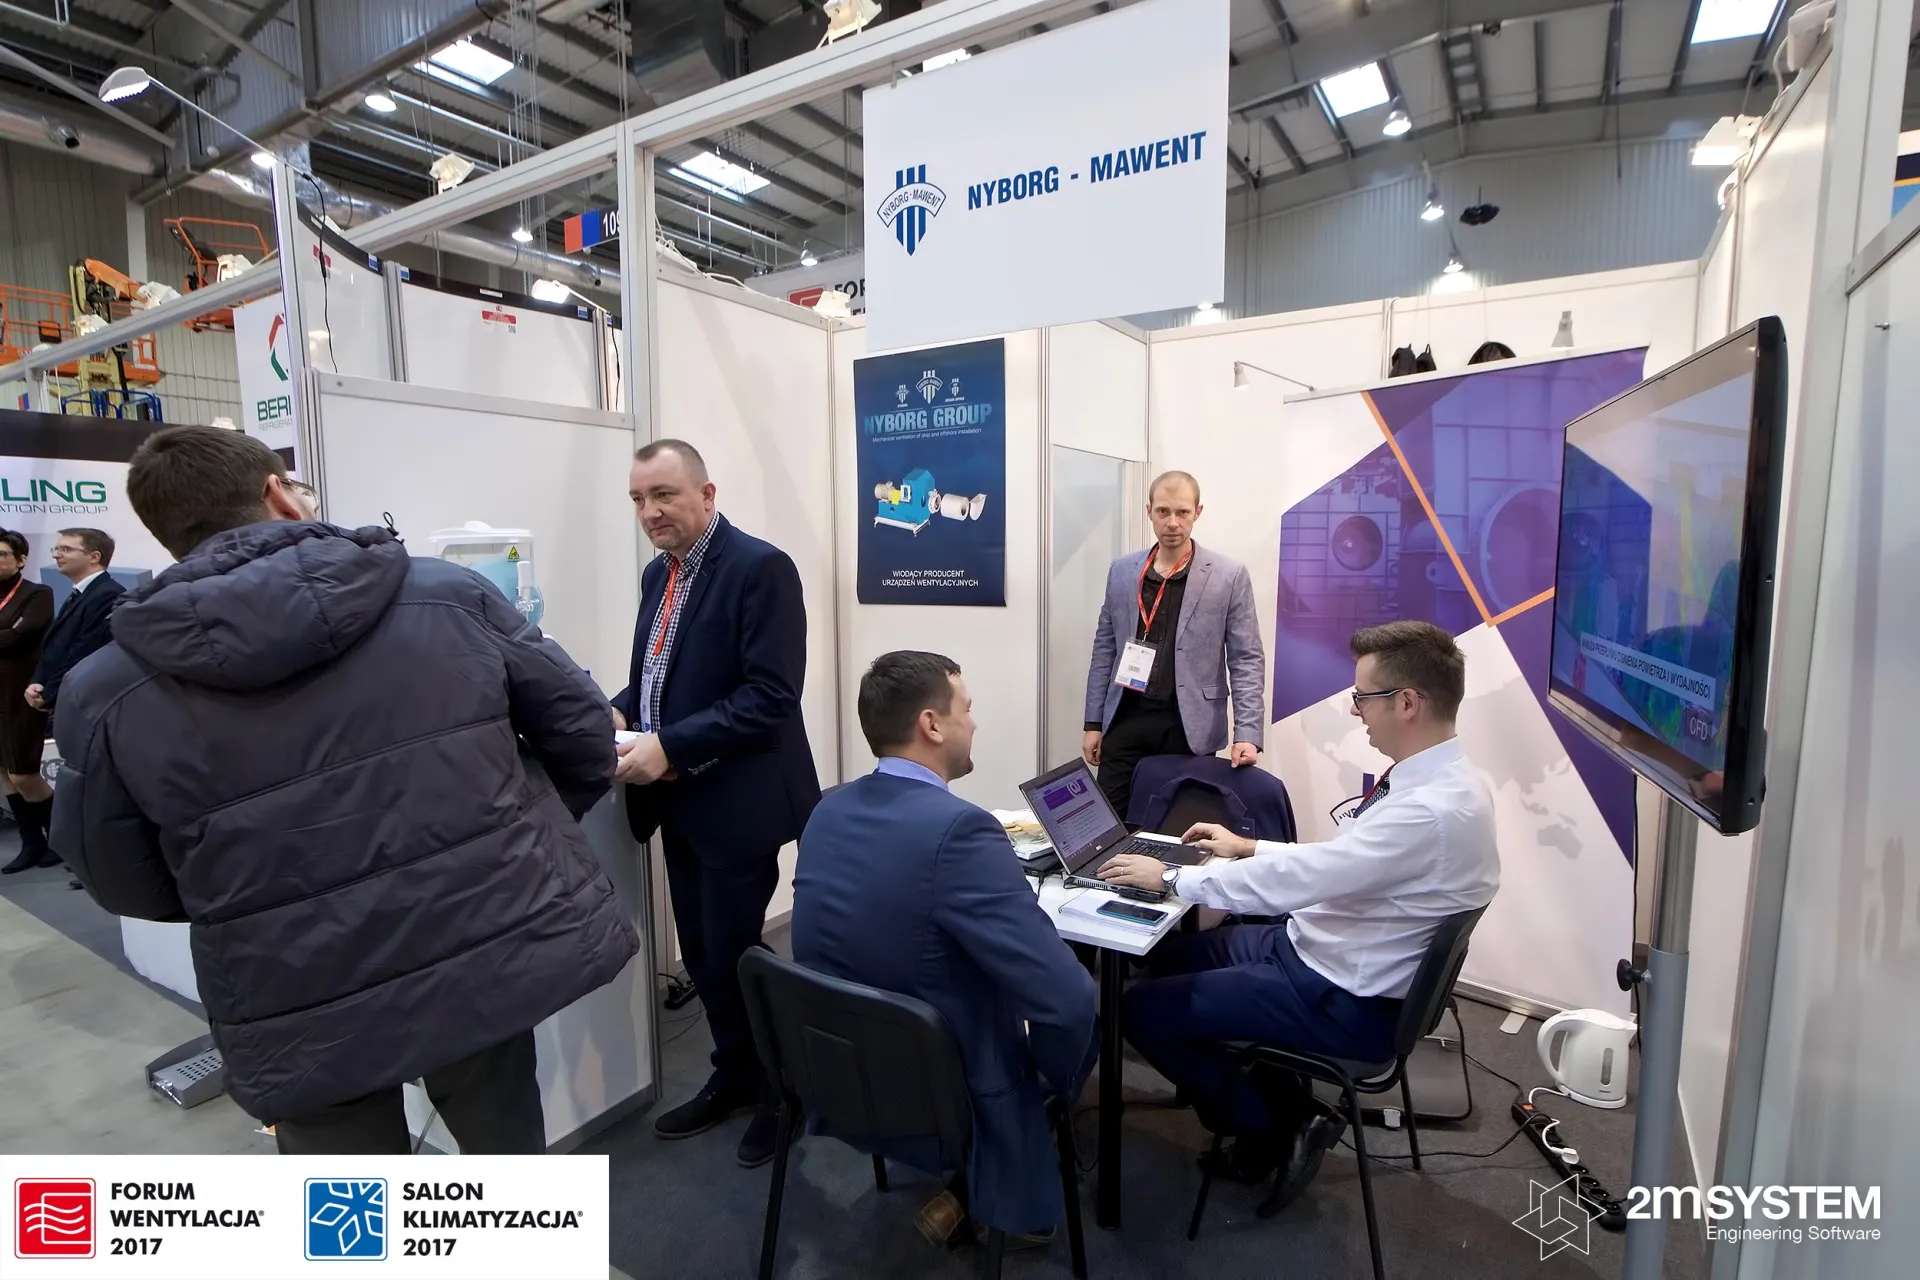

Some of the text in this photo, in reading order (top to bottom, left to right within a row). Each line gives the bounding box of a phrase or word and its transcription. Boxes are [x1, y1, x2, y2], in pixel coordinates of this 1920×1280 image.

[968, 166, 1059, 211] NYBORG
[1090, 130, 1207, 184] MAWENT
[882, 188, 942, 219] NYBORG MAWENT
[864, 403, 993, 436] NYBORG GROUP
[1, 478, 107, 503] LING
[49, 505, 108, 514] GROUP
[892, 570, 965, 580] WIODĄCY PRODUCENT
[917, 579, 979, 587] WENTYLACYJNYCH
[1670, 672, 1711, 699] WYDAJNOŚCI
[1689, 716, 1708, 740] CFD
